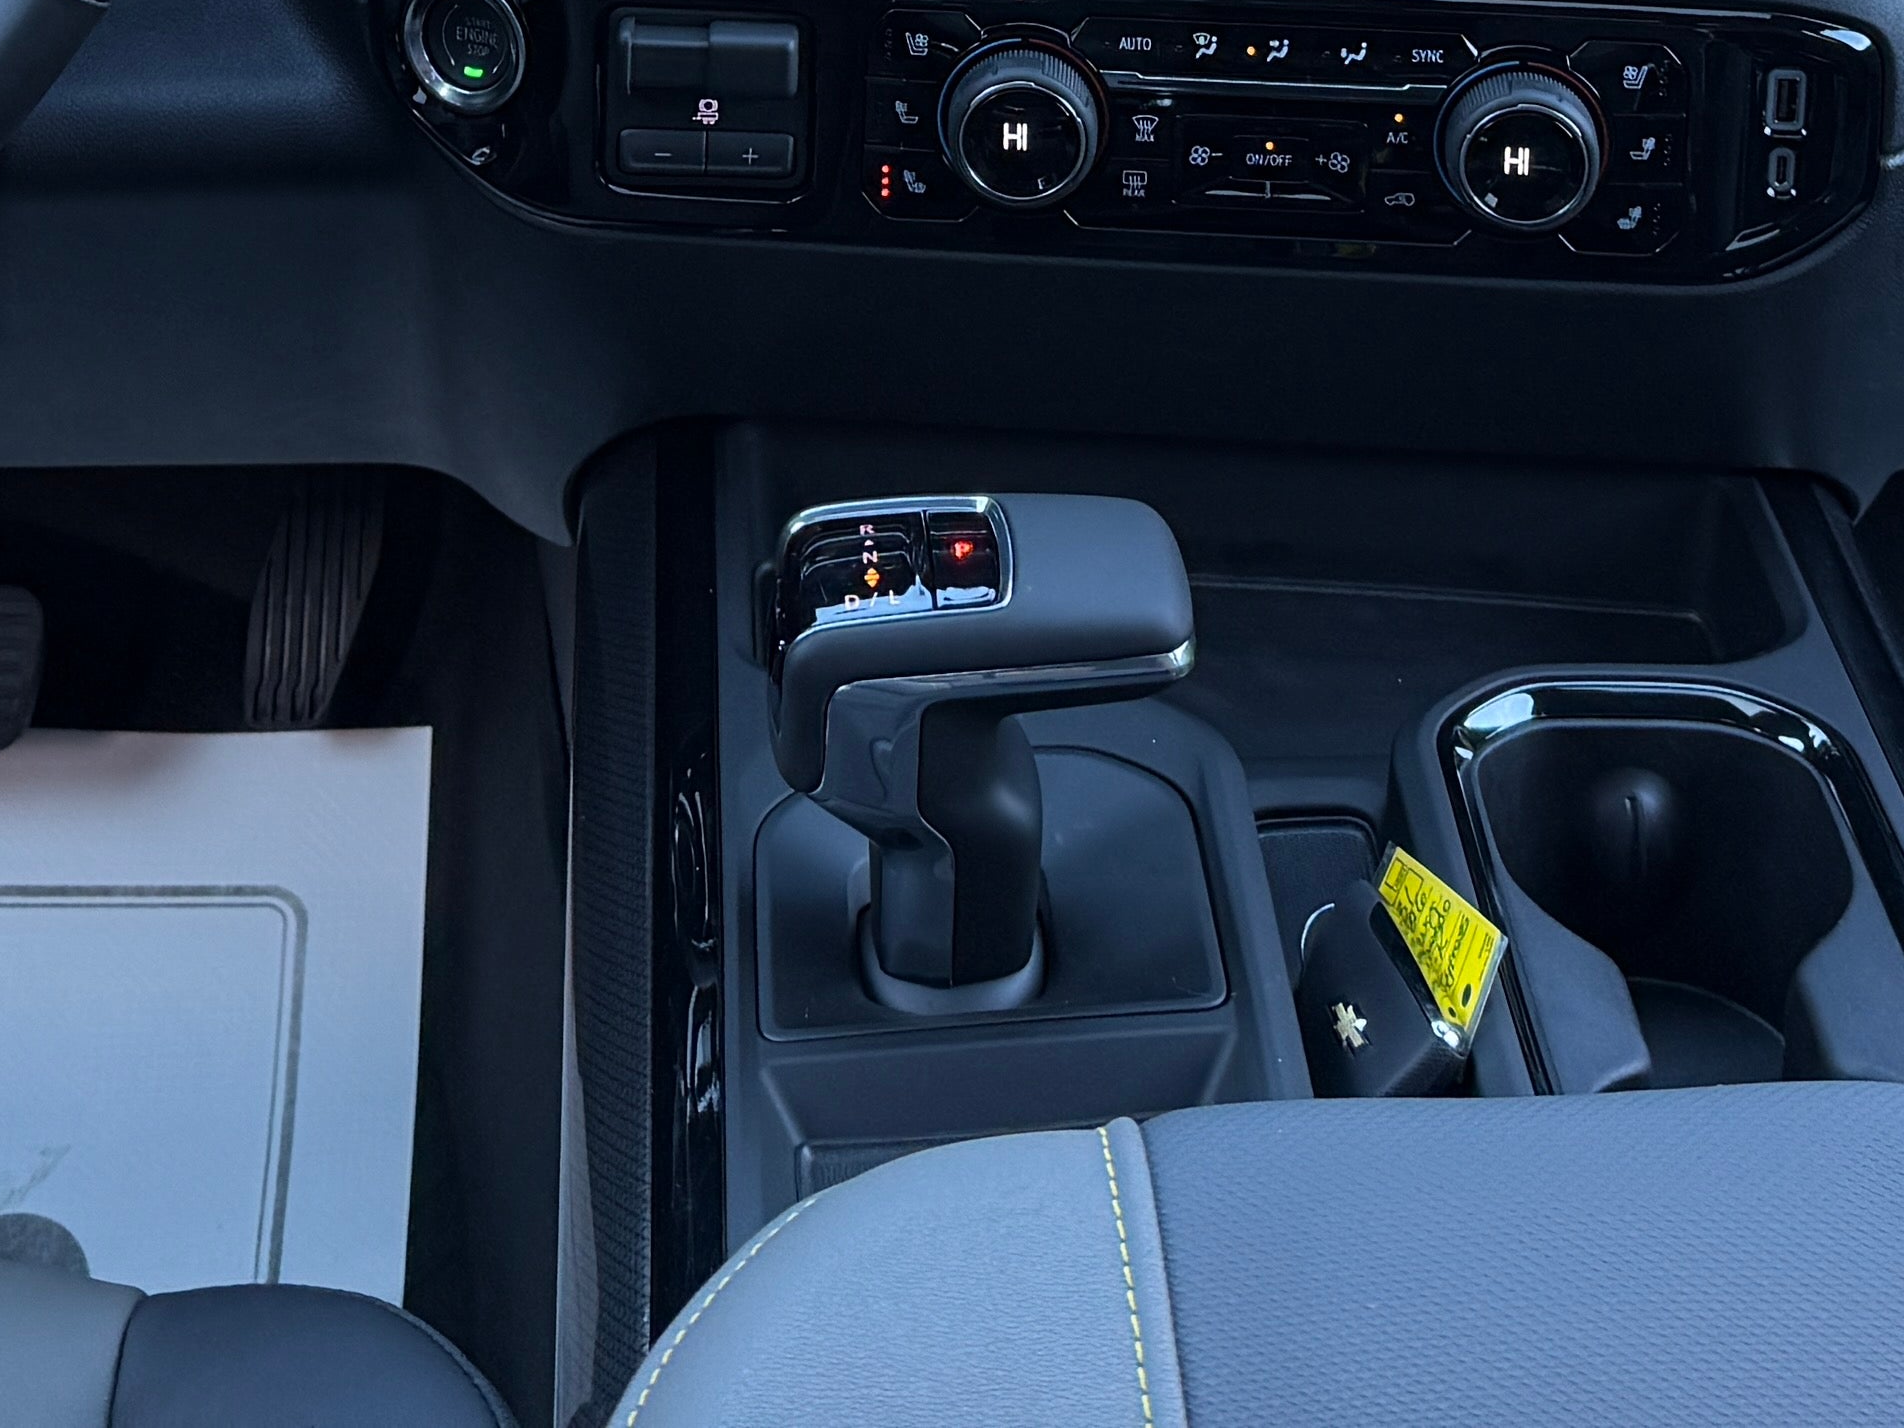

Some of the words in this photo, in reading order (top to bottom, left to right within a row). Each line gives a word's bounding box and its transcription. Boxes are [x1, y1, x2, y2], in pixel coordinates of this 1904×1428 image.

[1119, 37, 1152, 51] AUTO
[1411, 49, 1444, 63] SYNC
[1003, 122, 1028, 151] HI
[1386, 132, 1408, 144] A/C
[1246, 154, 1293, 166] ON/OFF
[1503, 146, 1530, 176] HI
[860, 524, 875, 536] R
[953, 540, 974, 559] P
[863, 551, 878, 564] N
